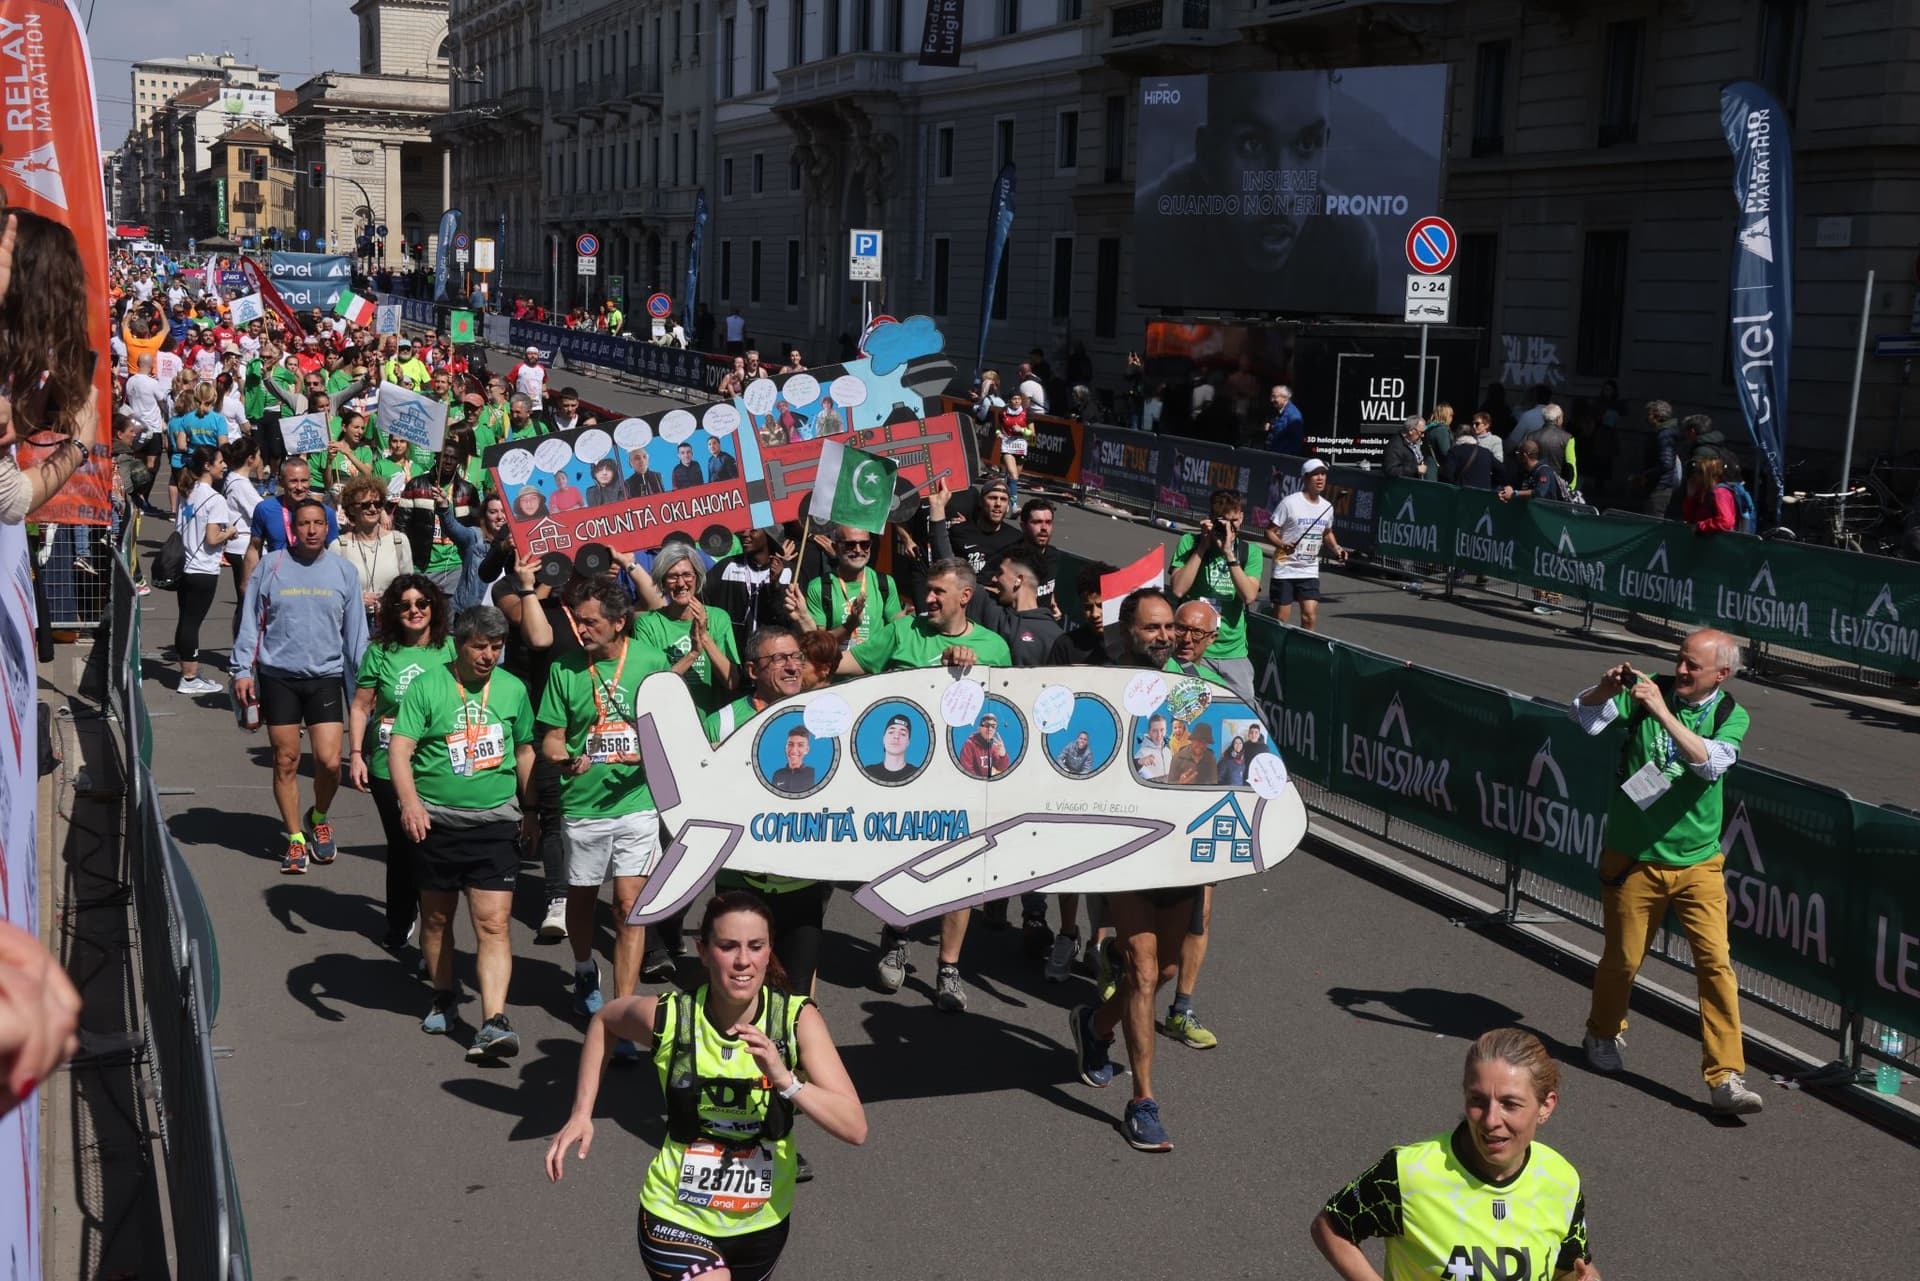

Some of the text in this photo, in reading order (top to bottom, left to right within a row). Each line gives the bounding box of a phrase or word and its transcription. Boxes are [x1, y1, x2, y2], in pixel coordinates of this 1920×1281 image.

[941, 0, 959, 54] Luigi R
[0, 17, 33, 131] RELAY
[25, 14, 52, 131] MARATHON
[1757, 108, 1770, 212] MARATHON
[1242, 170, 1317, 191] INSIEME
[1158, 194, 1408, 216] QUANDO NON ERI PRONTO
[860, 236, 873, 254] P
[273, 262, 312, 277] enel
[1411, 281, 1420, 292] 0
[1429, 281, 1445, 292] 24
[706, 365, 732, 388] TOYO
[1369, 377, 1405, 398] LED
[1361, 400, 1408, 422] WALL
[660, 489, 745, 524] OKLAHOMA
[1378, 516, 1438, 552] LEVISSIMA
[1456, 528, 1514, 570] LEVISSIMA
[1534, 546, 1605, 592] LEVISSIMA
[1619, 564, 1696, 612] LEVISSIMA
[1717, 585, 1809, 638] LEVISSIMA
[1830, 608, 1920, 662] LEVISSIM
[600, 737, 630, 752] 658C
[1342, 723, 1453, 812] LEVISSIMA
[1056, 801, 1088, 811] VIAGGIO
[863, 809, 970, 841] OKLAHOMA
[698, 1167, 756, 1194] 2377C
